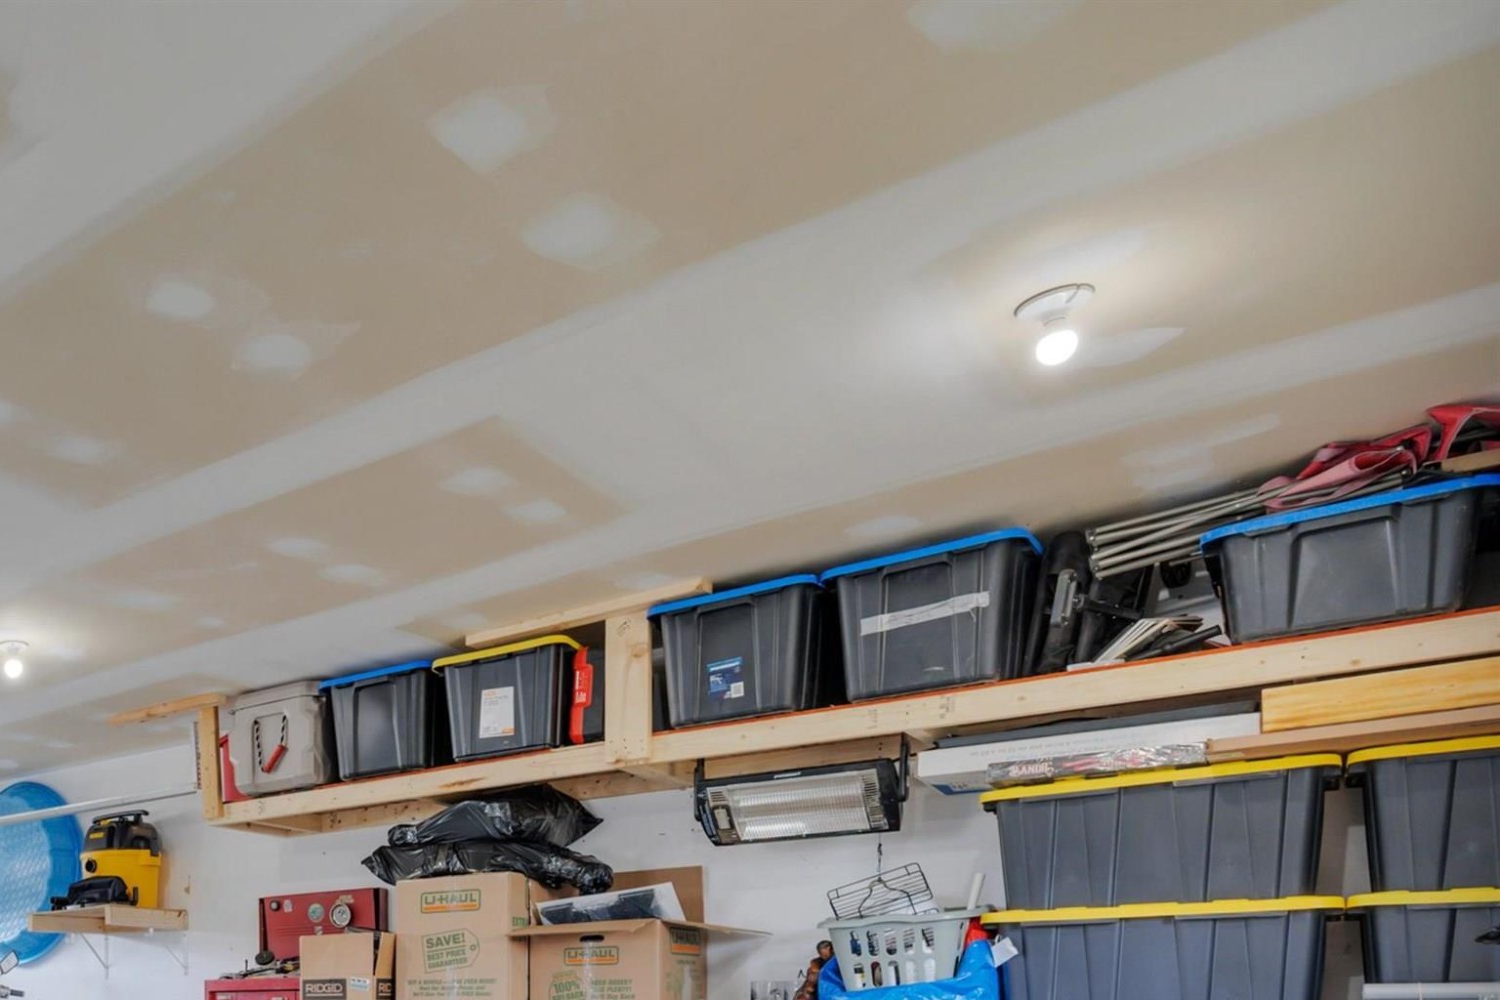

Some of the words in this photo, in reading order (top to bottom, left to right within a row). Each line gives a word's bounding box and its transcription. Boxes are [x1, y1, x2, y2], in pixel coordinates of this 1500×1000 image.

[424, 892, 477, 905] U-HAUL
[425, 932, 465, 949] SAVE!
[305, 983, 343, 993] RIDGID
[554, 981, 580, 994] 100%
